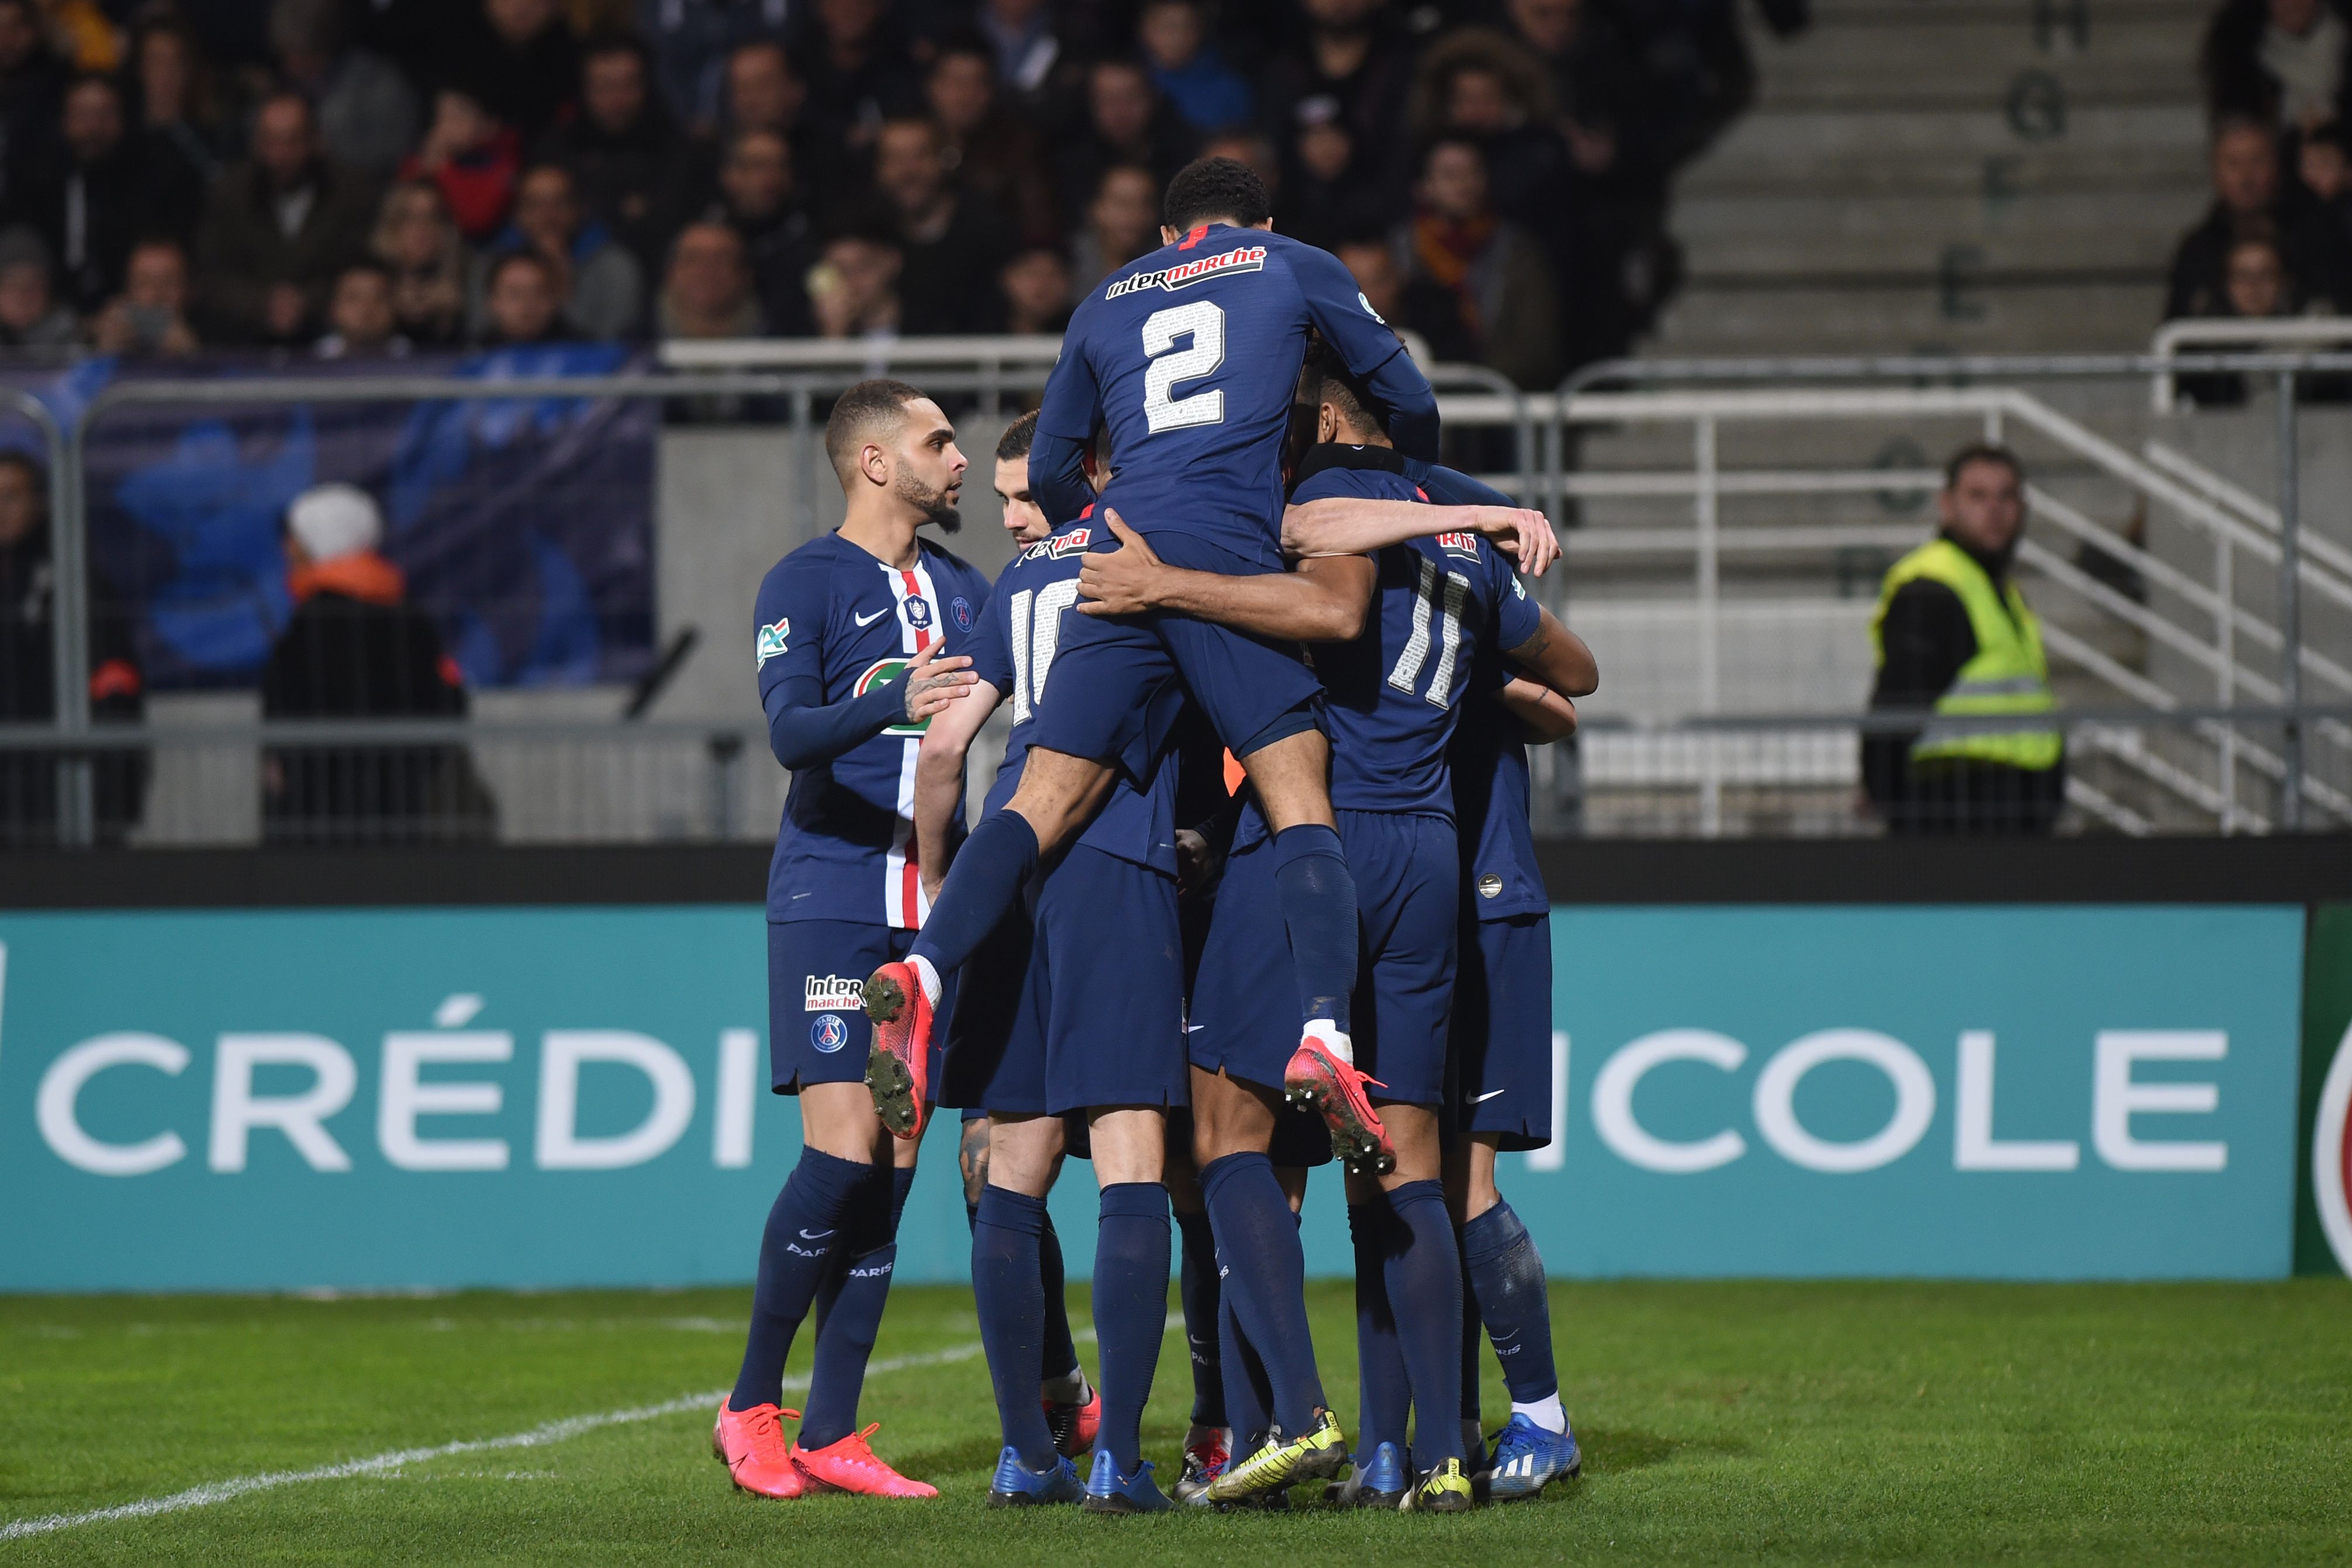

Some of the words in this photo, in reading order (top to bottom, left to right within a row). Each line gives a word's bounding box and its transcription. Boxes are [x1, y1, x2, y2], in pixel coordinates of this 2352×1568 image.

[1141, 300, 1225, 434] 2
[1387, 557, 1471, 710] 11
[36, 995, 759, 1176] CRÉDI
[816, 1016, 841, 1027] PARIS
